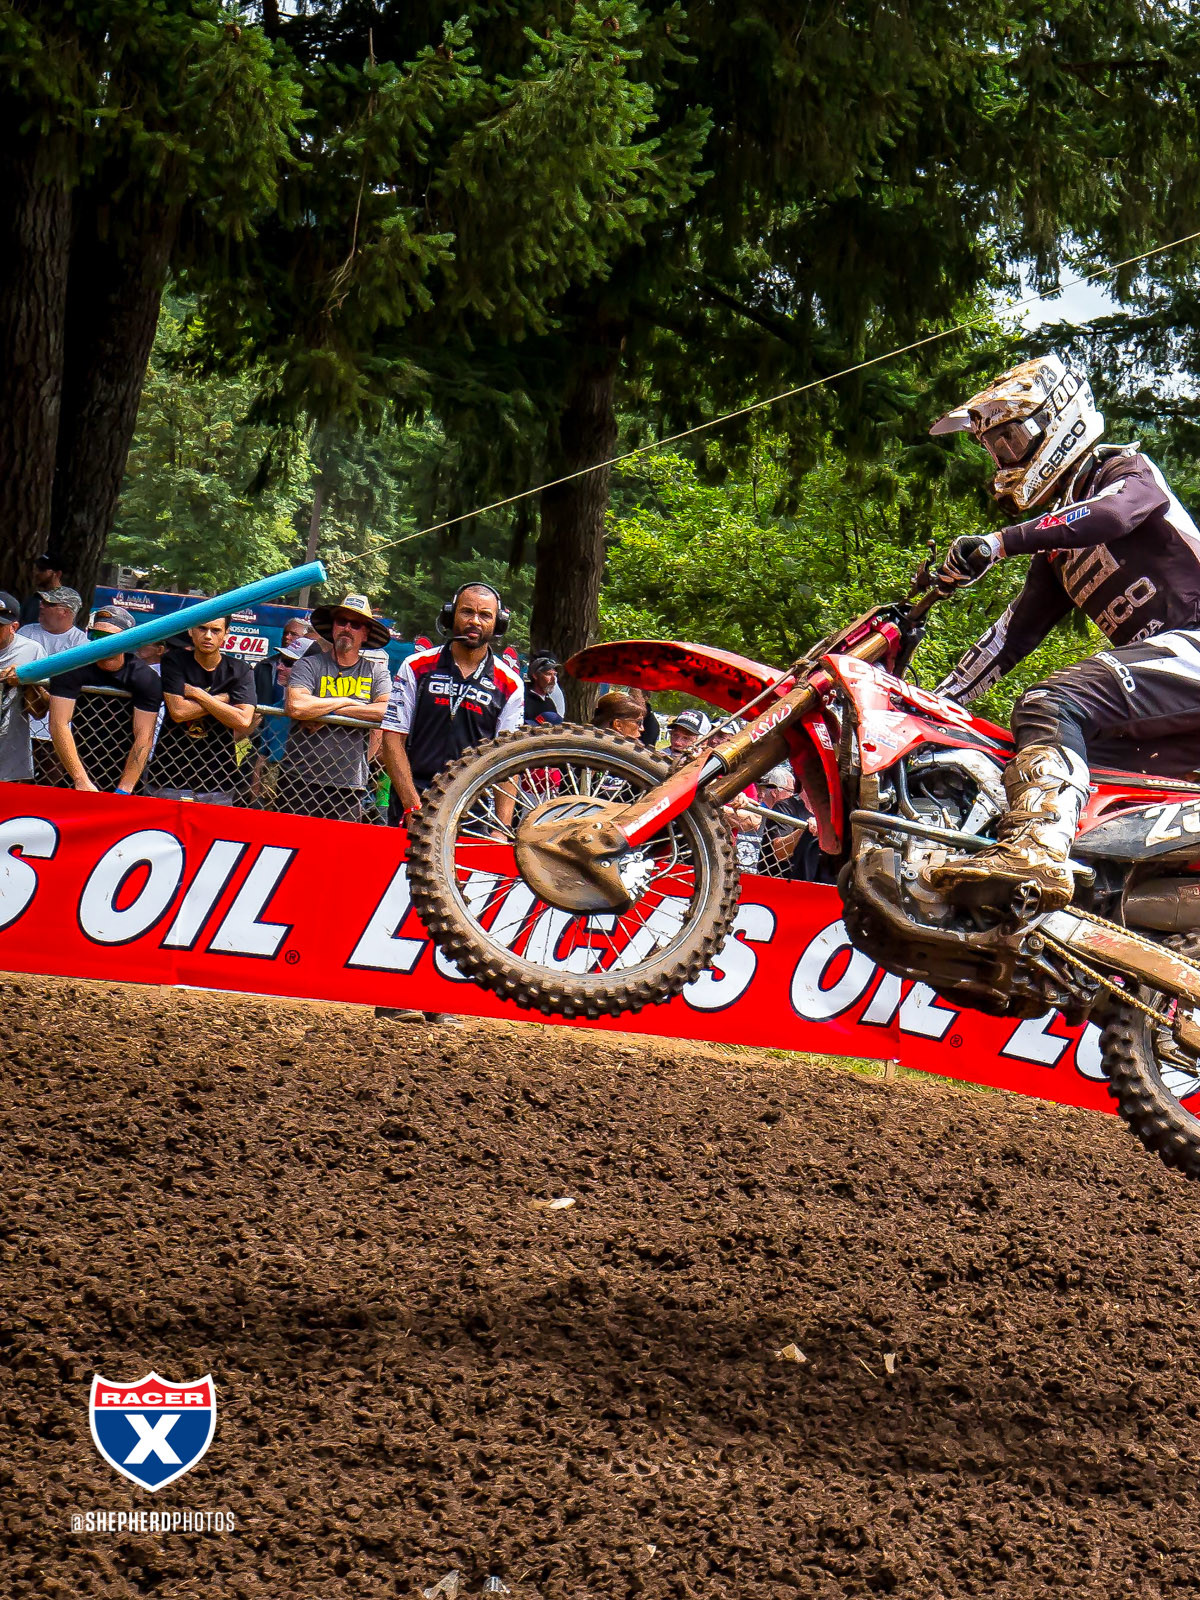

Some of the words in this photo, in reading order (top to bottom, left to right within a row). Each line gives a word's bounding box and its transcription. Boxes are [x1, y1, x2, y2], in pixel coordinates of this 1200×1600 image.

[1033, 364, 1058, 397] 23
[1038, 419, 1087, 481] GEICO
[239, 637, 265, 653] OIL
[319, 675, 373, 700] RIDE
[837, 656, 975, 723] GEICO
[1094, 651, 1136, 693] GEICO
[428, 681, 493, 706] GEICO
[78, 828, 299, 960] OIL
